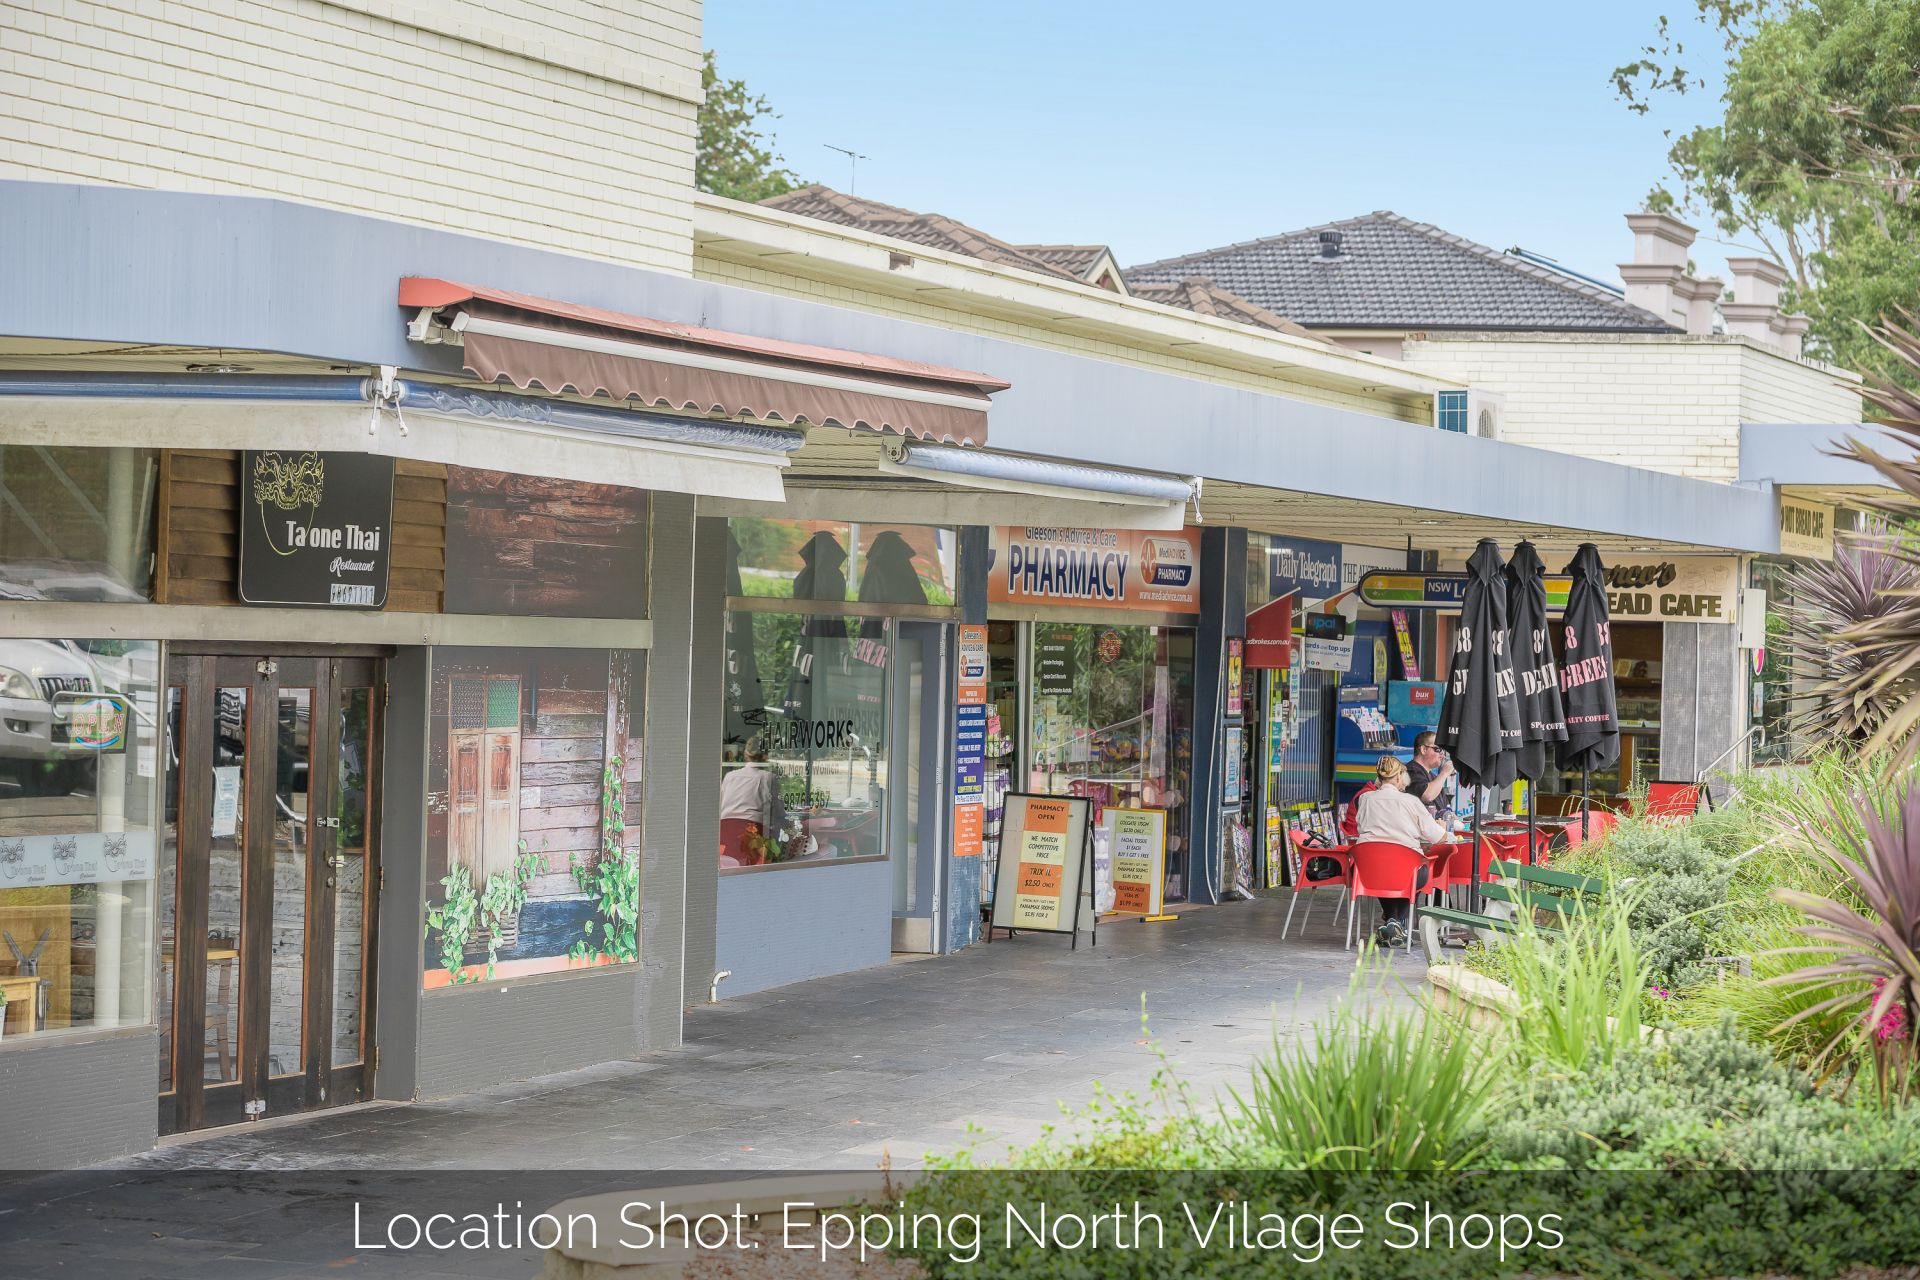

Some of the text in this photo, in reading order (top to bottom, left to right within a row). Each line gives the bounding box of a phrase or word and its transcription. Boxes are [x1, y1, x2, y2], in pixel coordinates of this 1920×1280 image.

[1796, 507, 1811, 536] BREAD
[1812, 510, 1824, 539] CAFE
[345, 524, 381, 551] Thai
[1065, 528, 1090, 545] Advice
[1093, 529, 1098, 545] &
[1100, 529, 1117, 547] Care
[330, 556, 375, 578] Restaurant
[1009, 544, 1128, 599] PHARMACY
[1158, 567, 1186, 581] PHARMACY
[1276, 550, 1299, 584] Daily
[1299, 551, 1337, 588] Telegraph
[1343, 563, 1357, 584] THE
[1428, 581, 1452, 592] NSW
[1607, 592, 1722, 617] EAD CAFE
[1246, 638, 1290, 646] adbrokes.com.au
[1305, 642, 1320, 650] ards
[1328, 643, 1340, 652] top
[1340, 645, 1351, 653] ups
[70, 713, 126, 736] OPEN
[1585, 714, 1610, 723] COFFEE
[761, 720, 854, 751] HAIRWORKS
[1030, 804, 1065, 812] PHARMACY
[1030, 867, 1044, 876] TRIX
